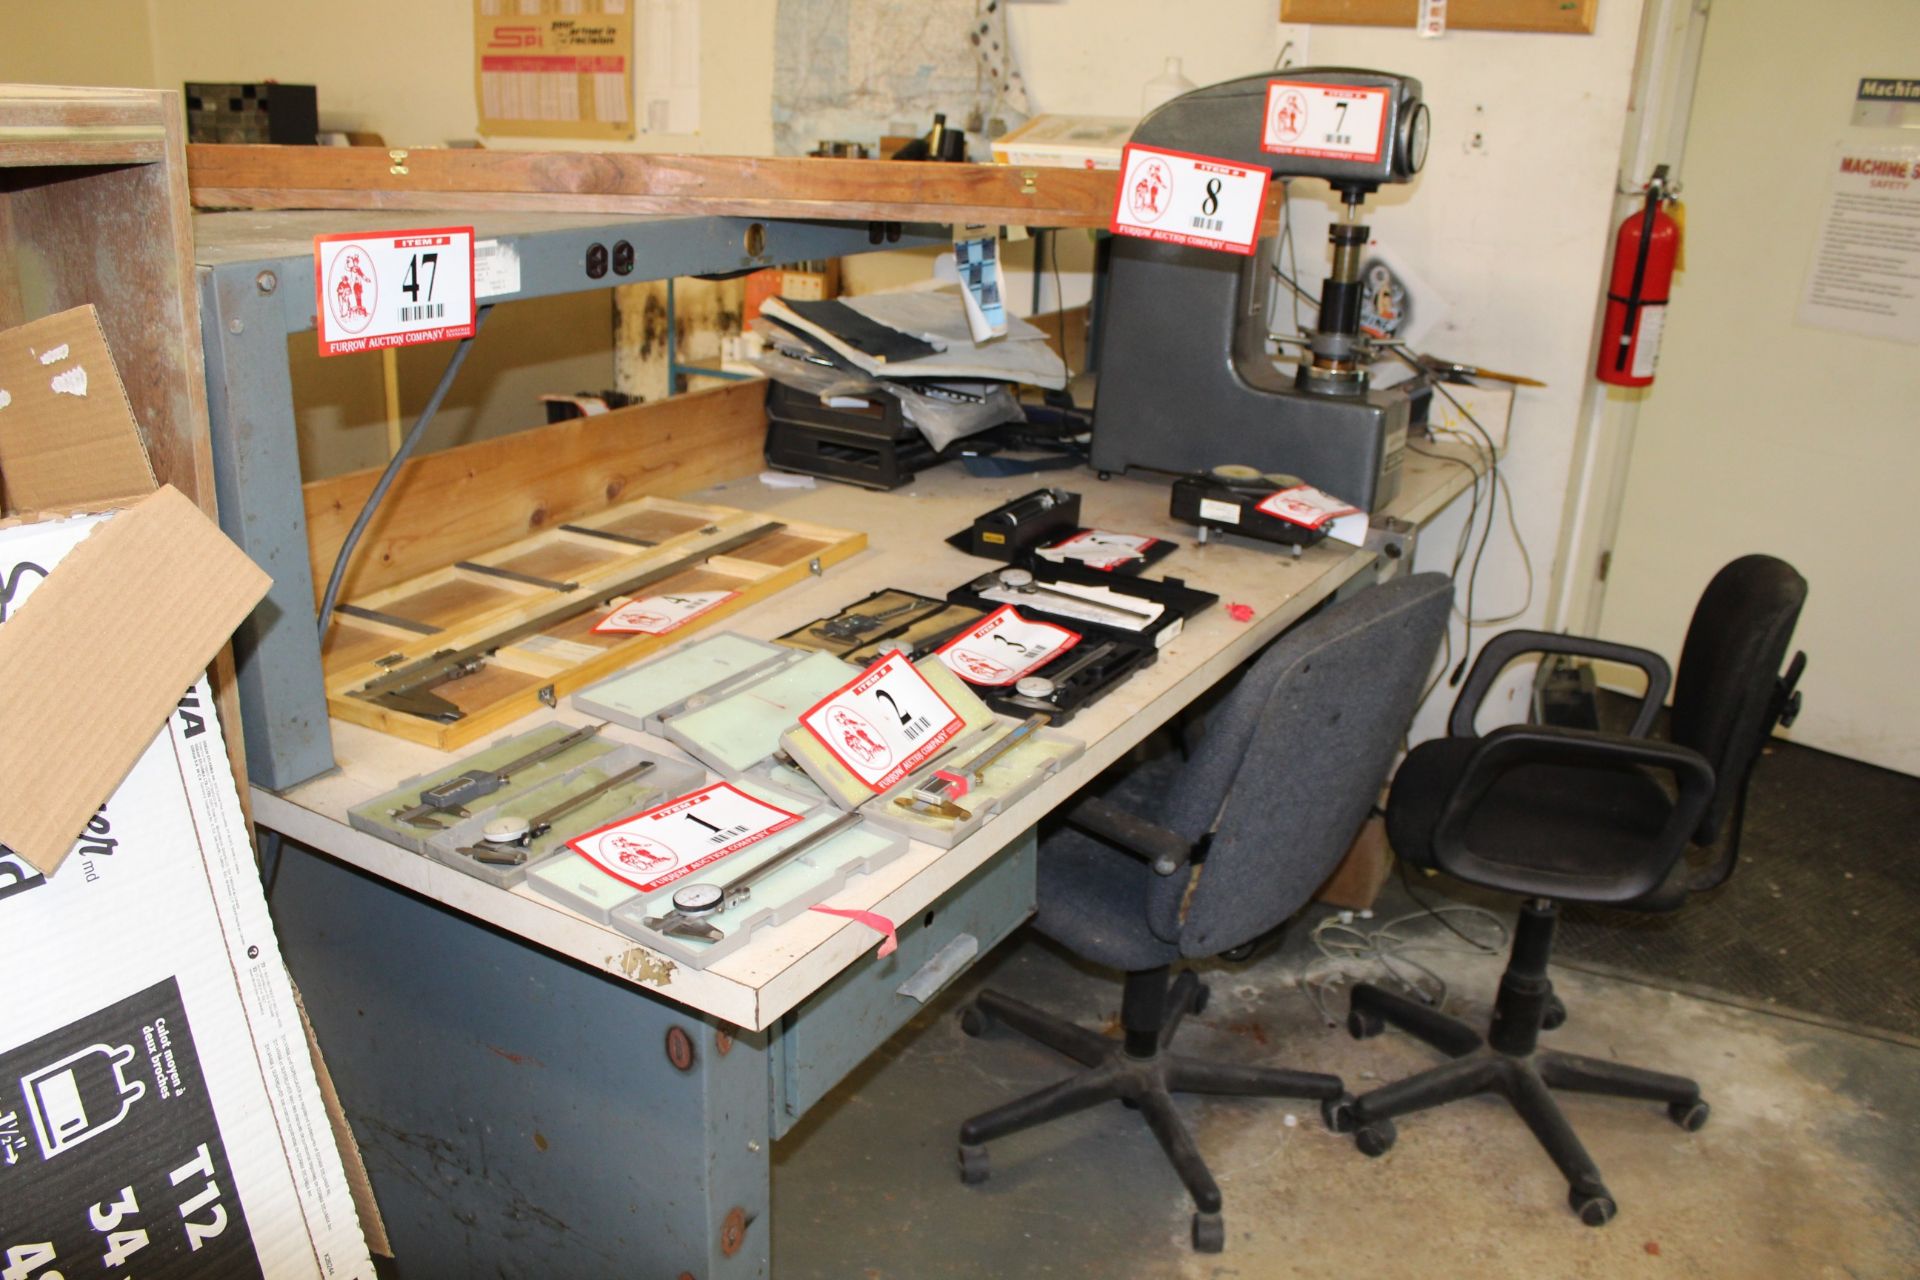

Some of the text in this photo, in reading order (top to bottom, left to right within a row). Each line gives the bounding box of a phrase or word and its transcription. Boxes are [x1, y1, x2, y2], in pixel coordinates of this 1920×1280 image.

[1336, 102, 1347, 132] 7
[1840, 156, 1907, 178] MACHINE
[1202, 178, 1221, 215] 8
[401, 239, 432, 247] ITEM
[1119, 225, 1152, 237] FURROW
[1152, 230, 1187, 244] AUCTION
[1187, 236, 1224, 250] COMPANY
[402, 253, 438, 302] 47
[330, 328, 444, 353] FURROW AUCTION COMPANY
[994, 634, 1027, 653] 3
[857, 674, 880, 693] ITEM
[875, 689, 912, 726] 2
[877, 765, 905, 789] FURROW
[902, 751, 925, 770] AUCTION
[920, 729, 948, 756] COMPANY
[658, 801, 690, 816] ITEM
[685, 812, 722, 833] 1
[82, 860, 100, 883] md
[649, 830, 769, 888] FURROW AUCTION COMPANY
[142, 1025, 170, 1099] deux broches
[155, 1018, 186, 1097] Culot moyen à
[169, 1143, 228, 1251] T12
[89, 1185, 150, 1269] 34
